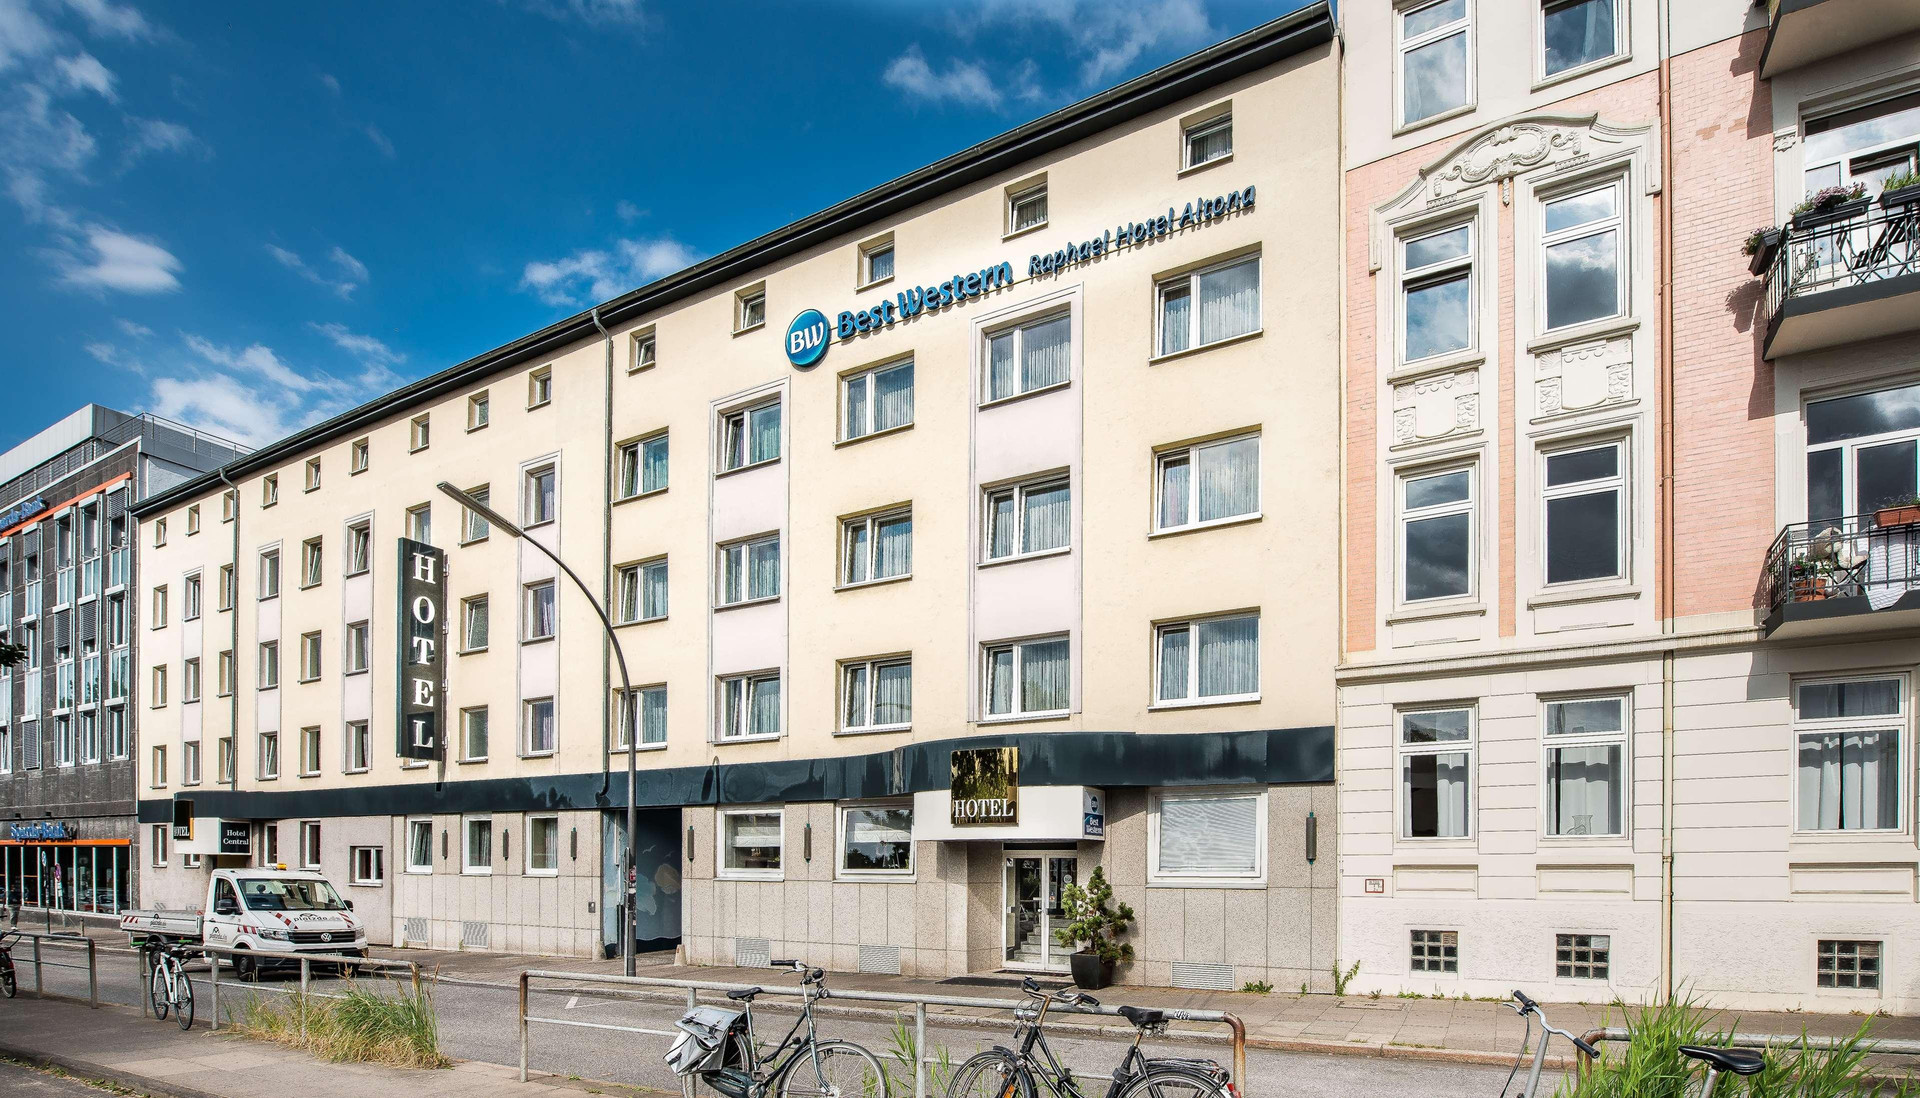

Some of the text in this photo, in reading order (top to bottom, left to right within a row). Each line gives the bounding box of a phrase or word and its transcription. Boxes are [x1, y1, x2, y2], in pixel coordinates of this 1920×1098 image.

[1028, 185, 1256, 277] Raphael Hotel Altona
[837, 261, 1013, 339] Best Western
[790, 322, 824, 354] BW
[412, 552, 436, 749] HOTEL
[954, 798, 1014, 818] HOTEL
[1086, 825, 1103, 834] Western
[1089, 817, 1099, 826] Best
[223, 837, 249, 845] Central
[226, 829, 246, 837] Hotel
